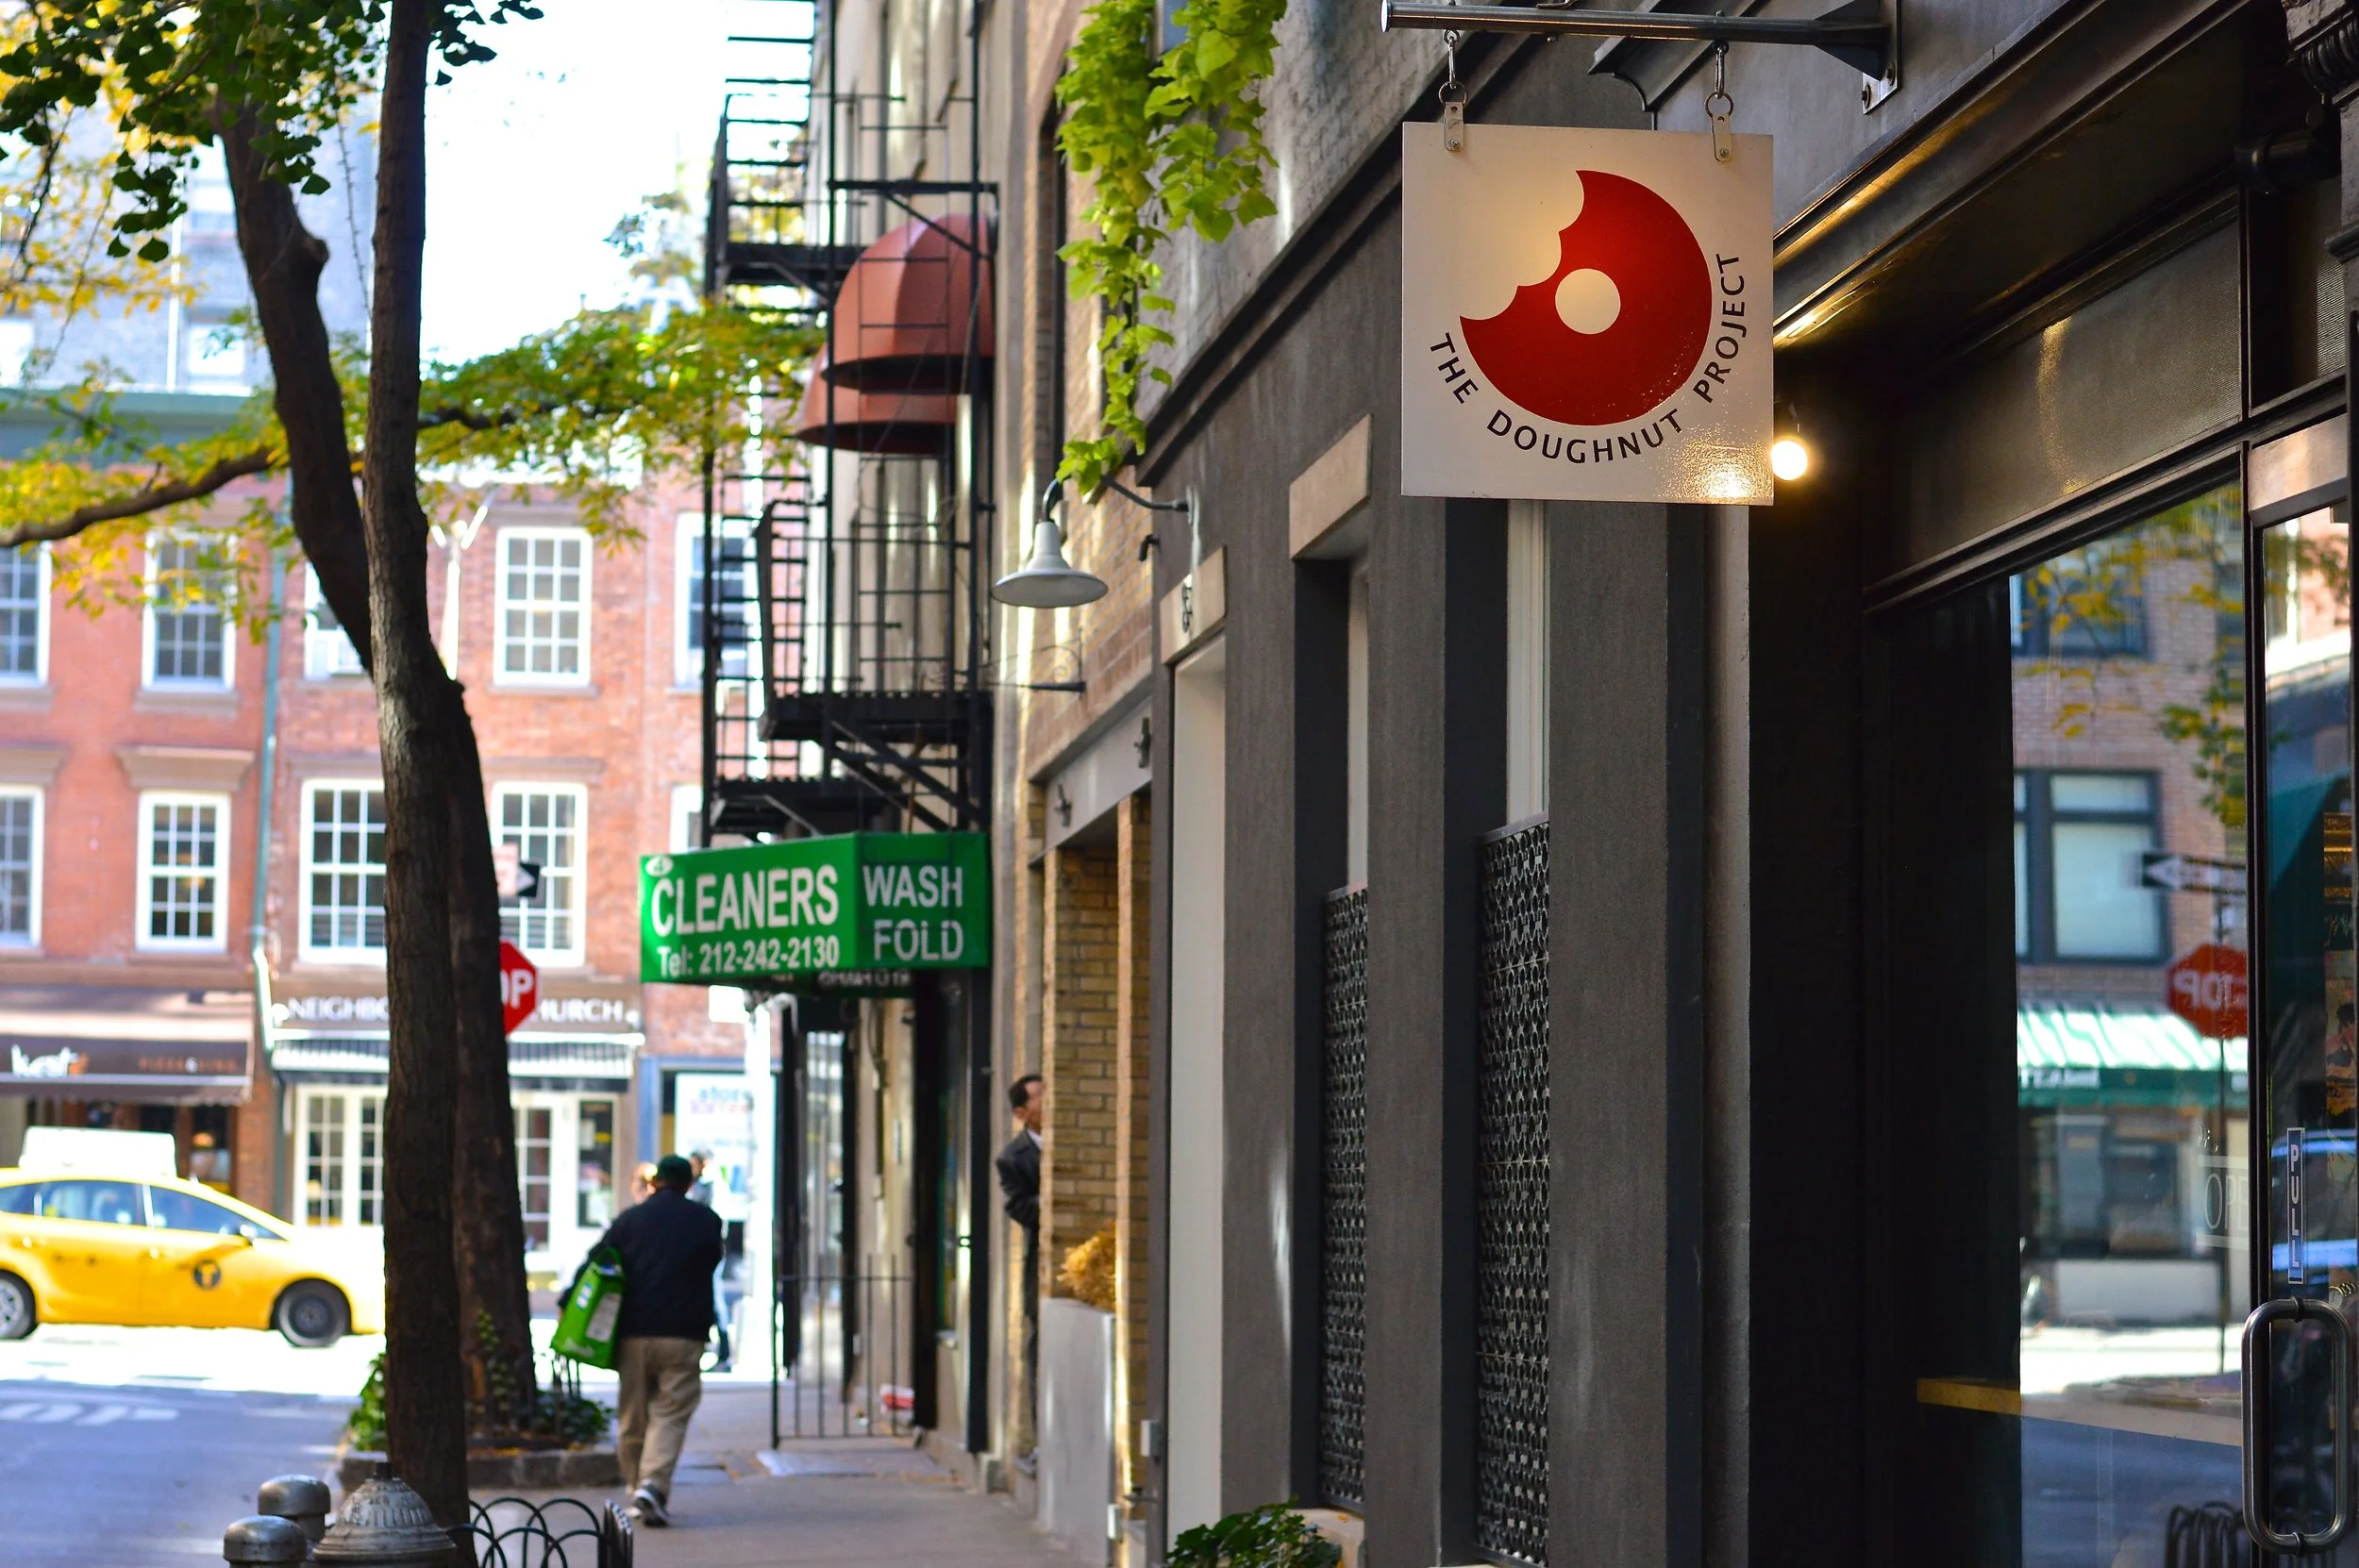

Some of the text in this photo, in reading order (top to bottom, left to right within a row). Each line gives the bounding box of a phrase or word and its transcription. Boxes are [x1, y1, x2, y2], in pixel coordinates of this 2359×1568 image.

[1430, 253, 1747, 464] THE DOUGHNUT PROJECT
[651, 865, 840, 937] CLEANERS
[862, 865, 963, 908] WASH
[657, 935, 840, 978] Tel: 212-242-2130
[873, 919, 963, 961] FOLD
[529, 998, 625, 1024] HURCH
[2204, 1173, 2248, 1230] OPE
[2289, 1143, 2300, 1269] PULL
